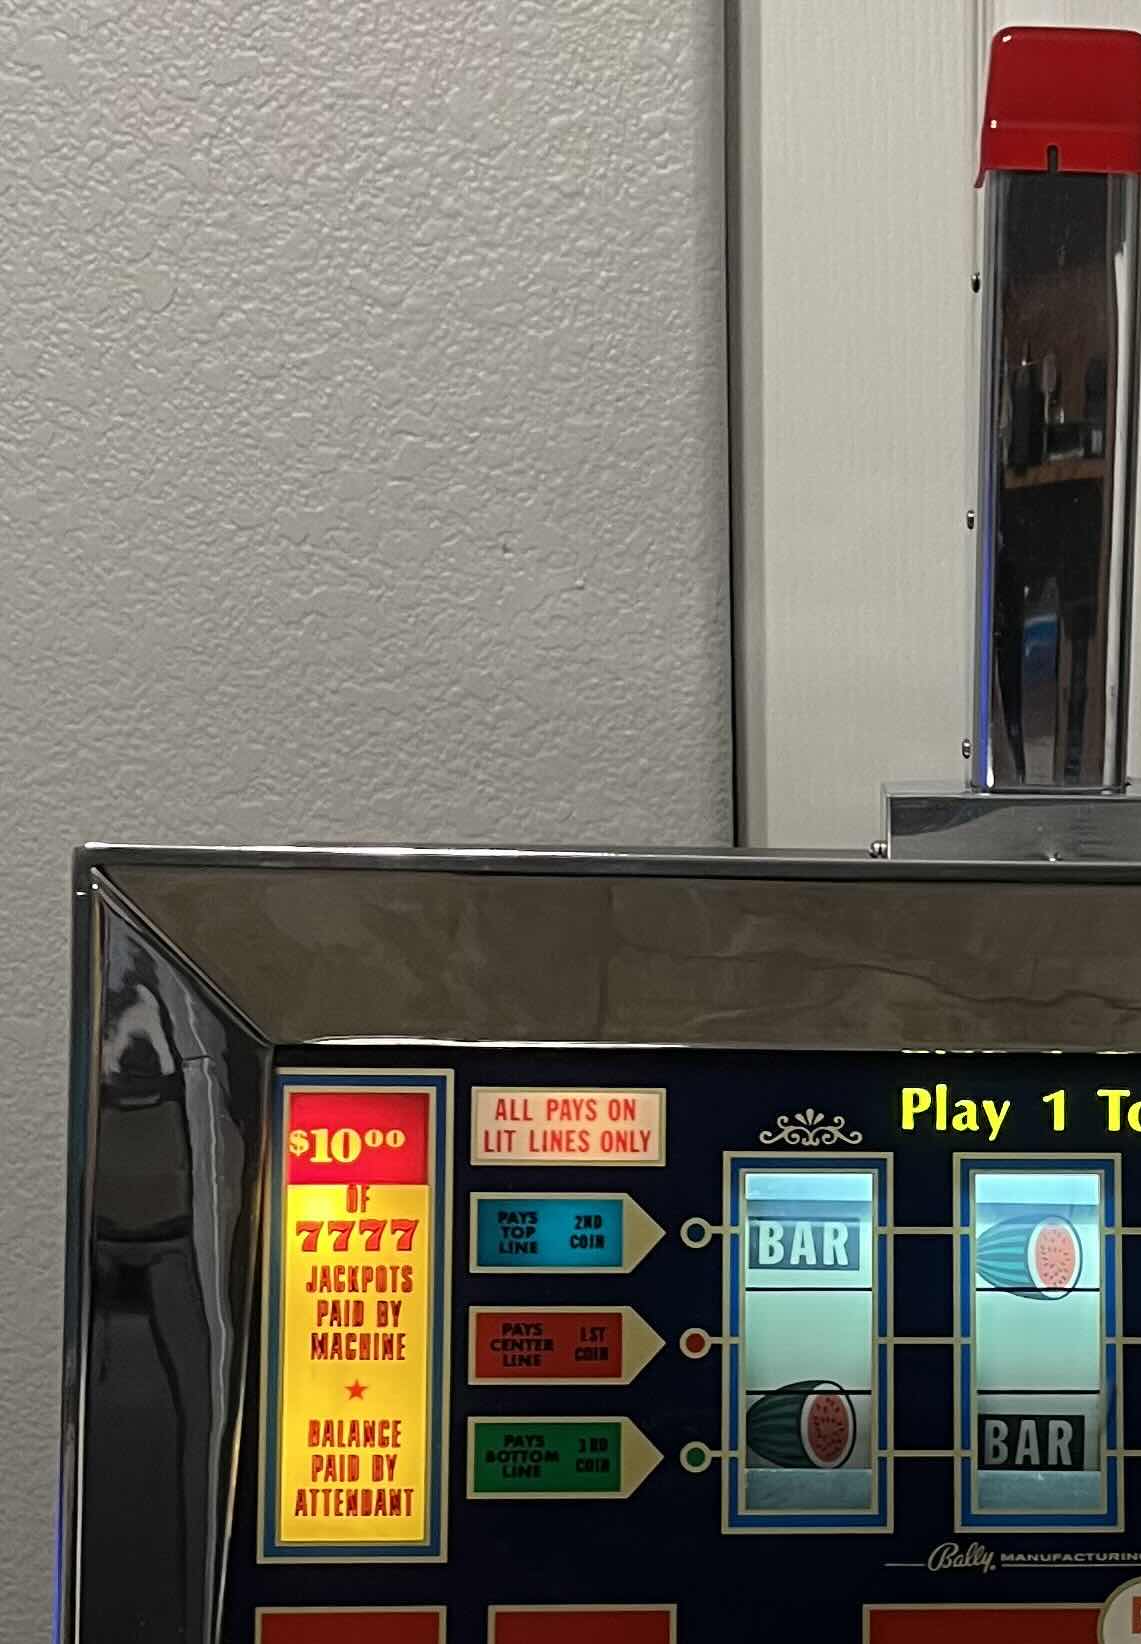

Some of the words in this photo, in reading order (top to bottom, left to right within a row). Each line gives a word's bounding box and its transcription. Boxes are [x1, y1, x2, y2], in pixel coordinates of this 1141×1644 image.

[495, 1098, 533, 1122] ALL
[546, 1098, 596, 1123] PAYS
[608, 1098, 636, 1122] ON
[901, 1083, 1011, 1141] Play
[1042, 1089, 1066, 1131] 1
[484, 1129, 516, 1153] LIT
[530, 1129, 590, 1153] LINES
[600, 1129, 652, 1153] ONLY
[346, 1184, 370, 1213] OF
[498, 1211, 538, 1225] PAYS
[574, 1215, 602, 1230] 2ND
[295, 1219, 419, 1252] 7777
[501, 1227, 536, 1239] TOP
[570, 1234, 605, 1249] COIN
[758, 1221, 850, 1268] BAR
[499, 1241, 538, 1255] LINE
[305, 1265, 413, 1293] JACKPOTS
[316, 1300, 364, 1327] PAID
[376, 1300, 402, 1327] BY
[502, 1323, 543, 1337] PAYS
[310, 1333, 406, 1360] MACHINE
[490, 1338, 554, 1352] CENTER
[503, 1354, 542, 1367] LINE
[307, 1420, 402, 1447] BALANCE
[504, 1434, 544, 1448] PAYS
[985, 1417, 1075, 1466] BAR
[311, 1454, 360, 1482] PAID
[372, 1454, 398, 1482] BY
[485, 1450, 560, 1464] BOTTOM
[502, 1465, 542, 1479] LINE
[294, 1488, 414, 1516] ATTENDANT
